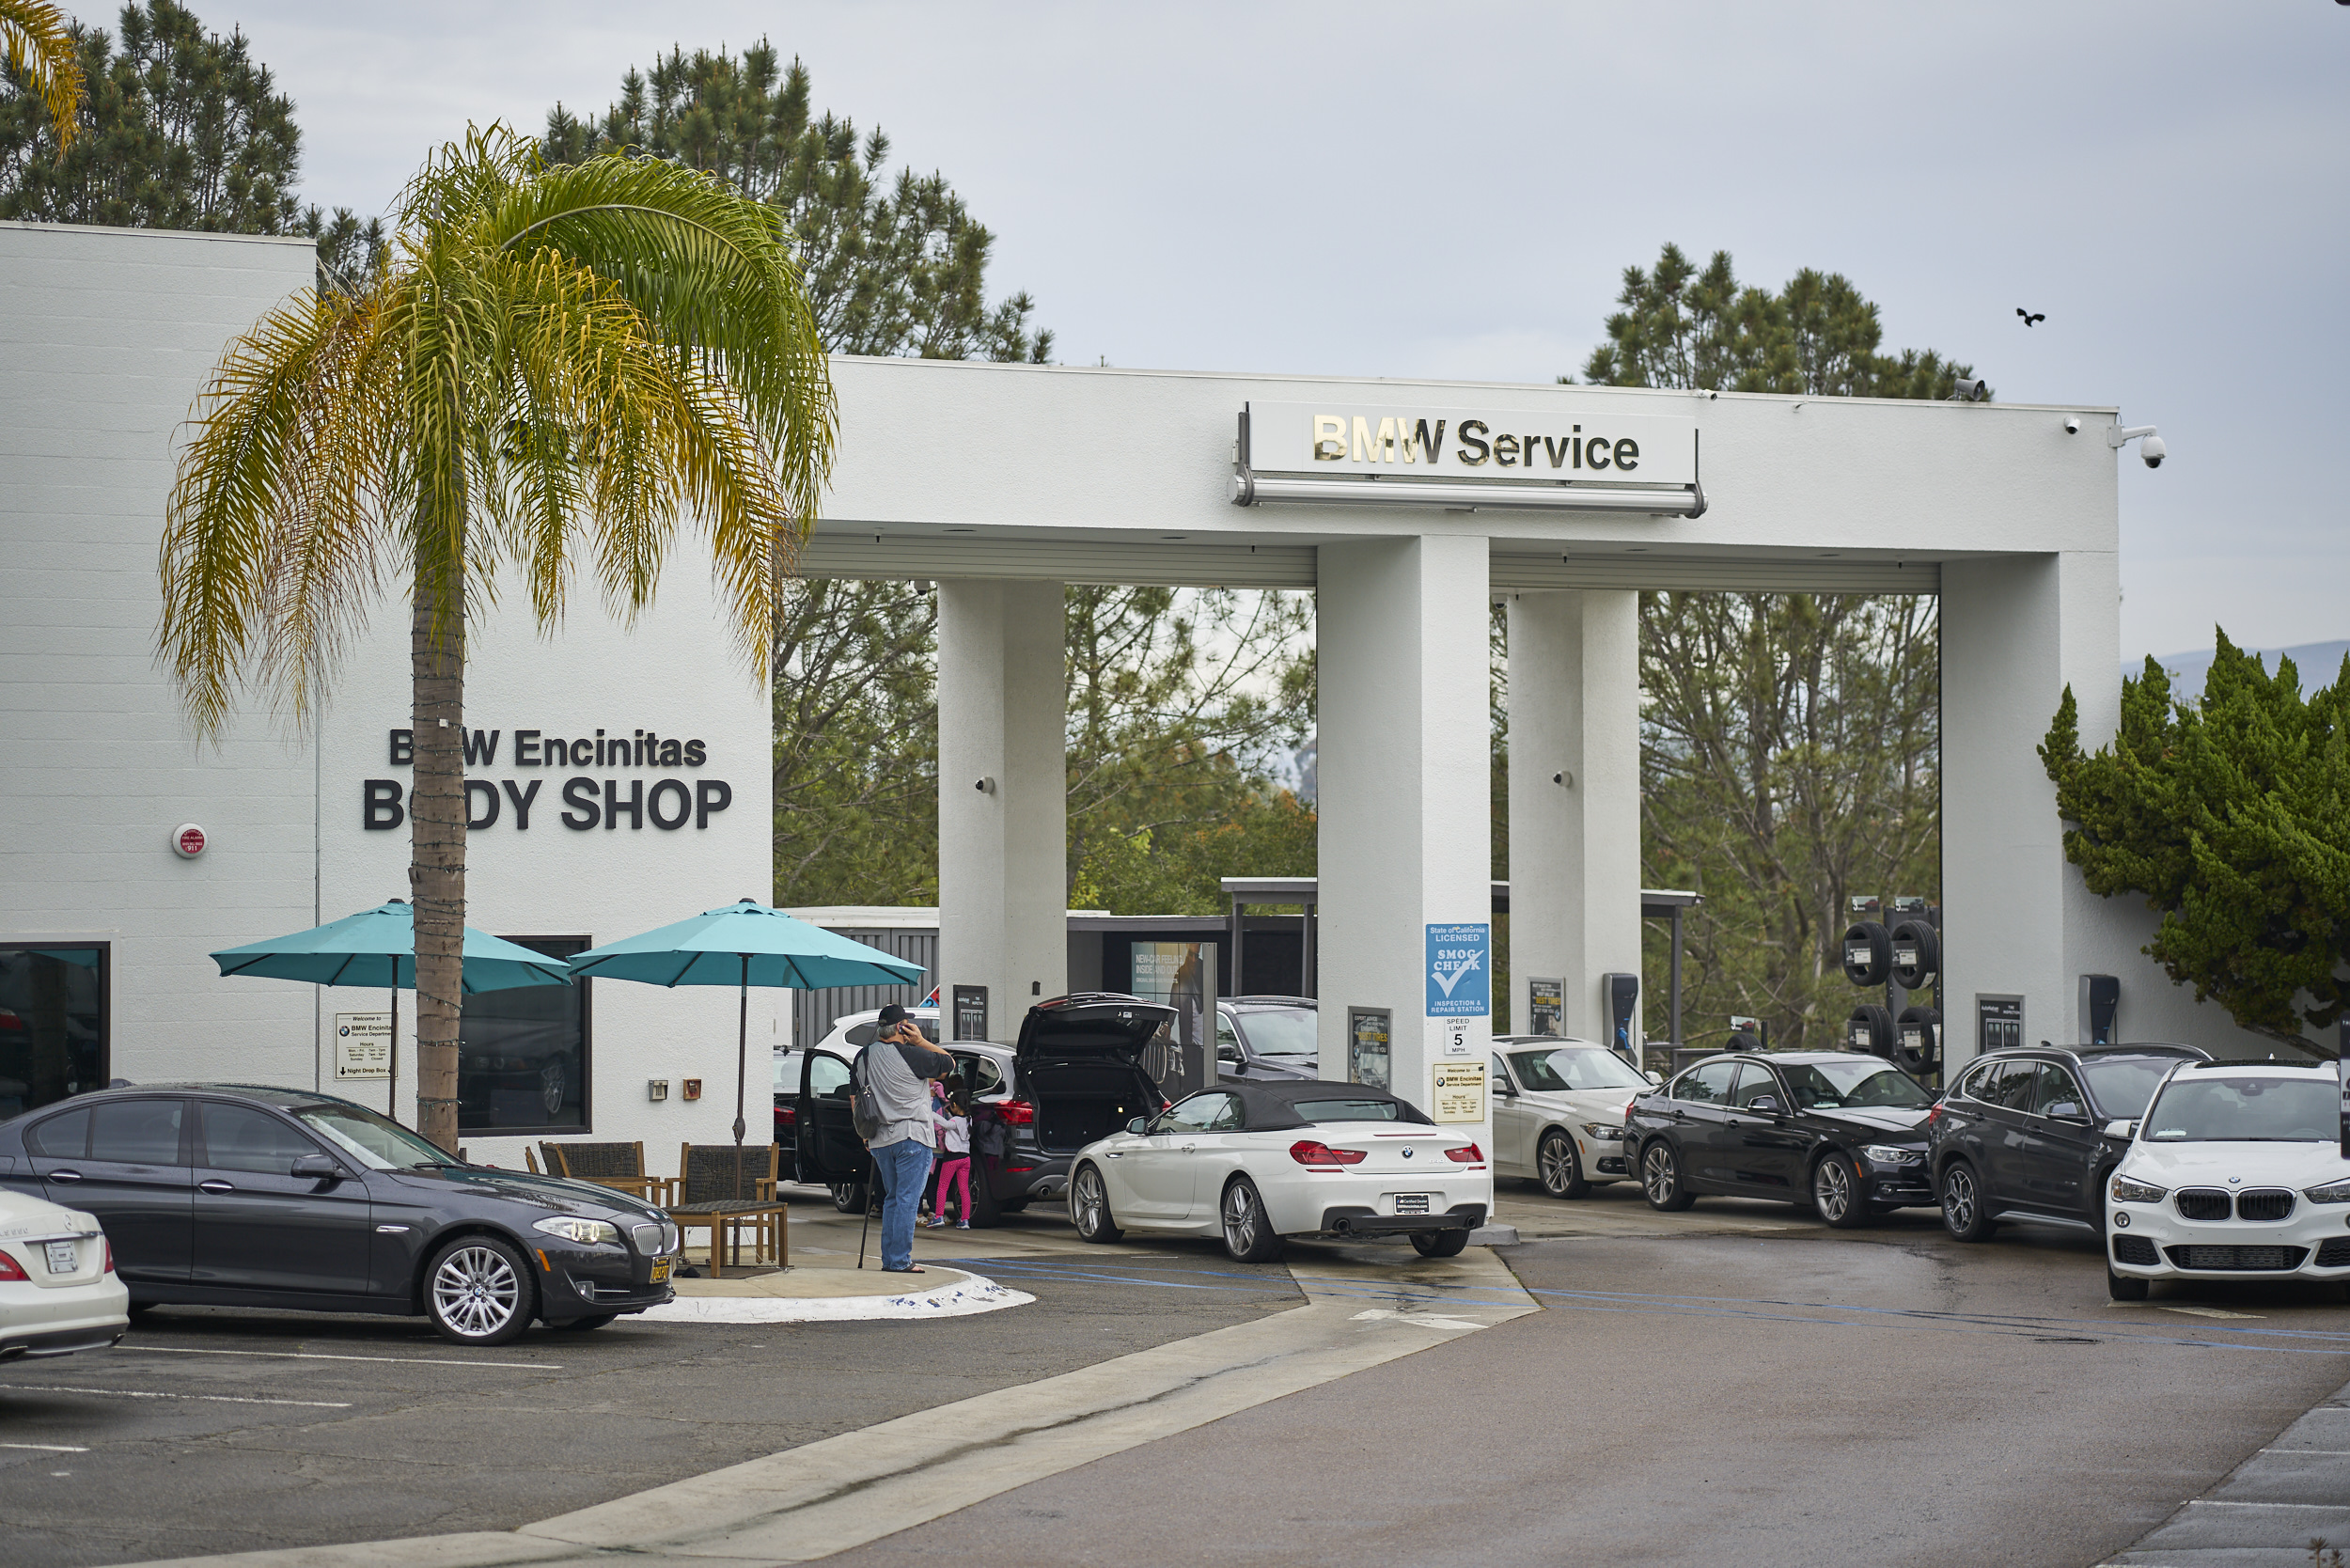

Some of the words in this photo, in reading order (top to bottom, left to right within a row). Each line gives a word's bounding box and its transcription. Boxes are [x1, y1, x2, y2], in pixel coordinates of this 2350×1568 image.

[1312, 415, 1447, 464] BMW
[1457, 419, 1640, 471] Service
[390, 729, 500, 766] BW
[515, 729, 707, 766] Encinitas
[364, 779, 543, 830] BDY
[561, 776, 731, 830] SHOP
[1896, 899, 1901, 911] 5
[1438, 949, 1476, 959] SMOG
[1136, 965, 1152, 974] INSIDE
[1358, 1032, 1372, 1041] BEST
[1373, 1033, 1387, 1042] TIRES
[1454, 1034, 1463, 1045] 5
